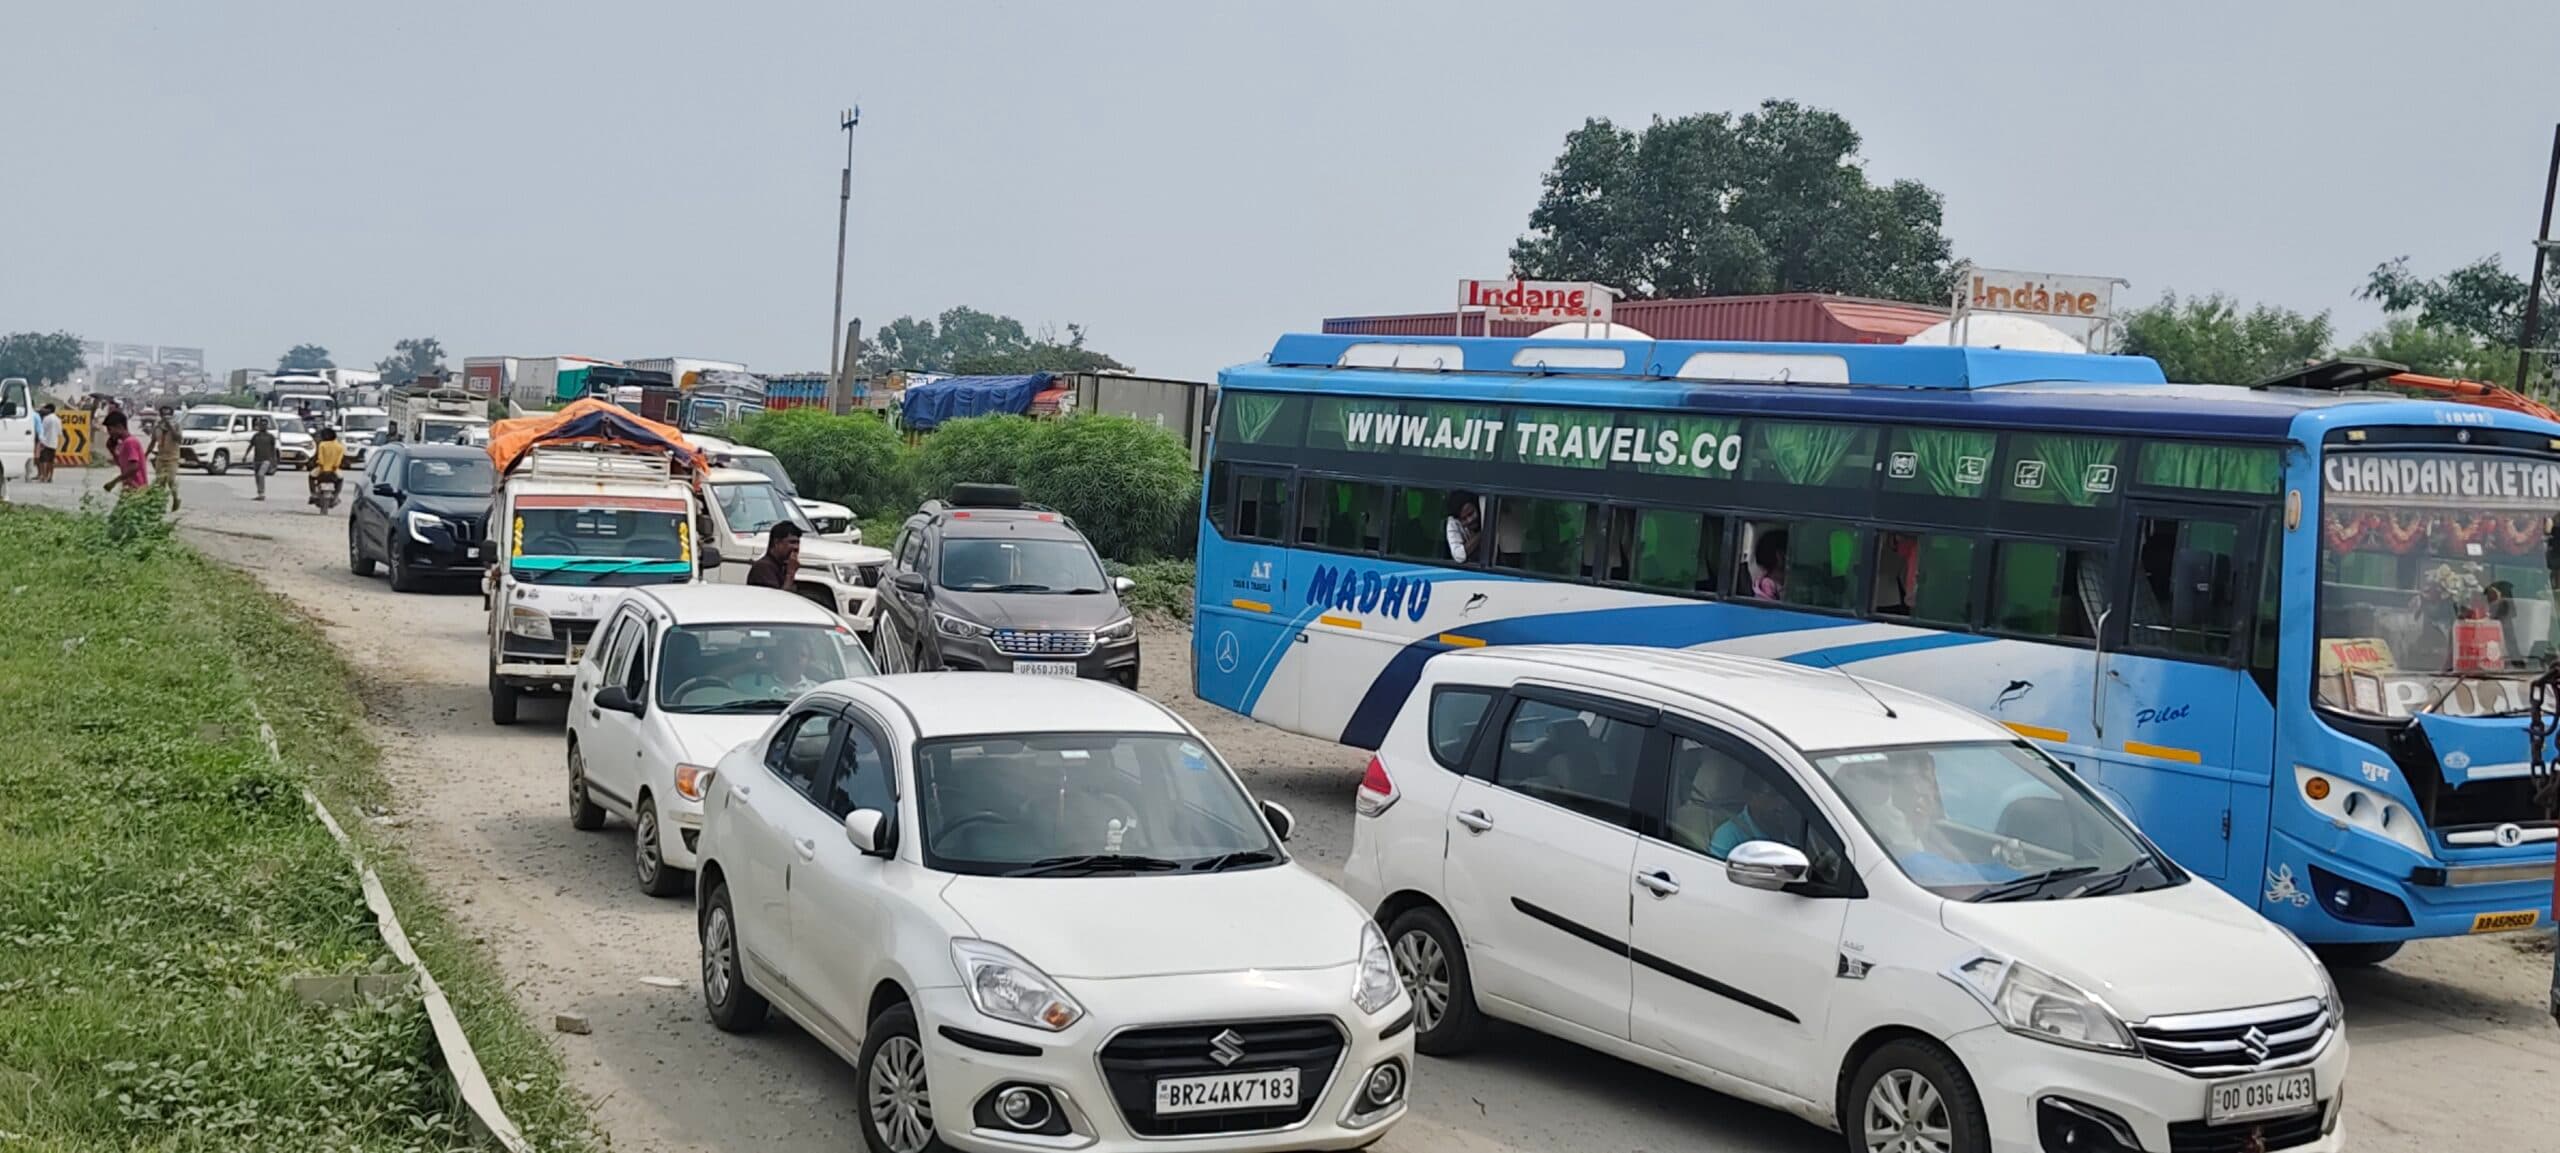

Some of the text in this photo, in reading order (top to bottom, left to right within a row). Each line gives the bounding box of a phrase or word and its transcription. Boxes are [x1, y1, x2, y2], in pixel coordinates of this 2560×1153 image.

[1975, 276, 2097, 315] Indane
[1348, 412, 1742, 471] WWW.AJIT TRAVELS.CO
[1306, 564, 1432, 622] MADHU
[2136, 704, 2190, 728] Pilot
[1170, 1078, 1293, 1106] BR24AK7183
[2277, 1077, 2311, 1102] 4433
